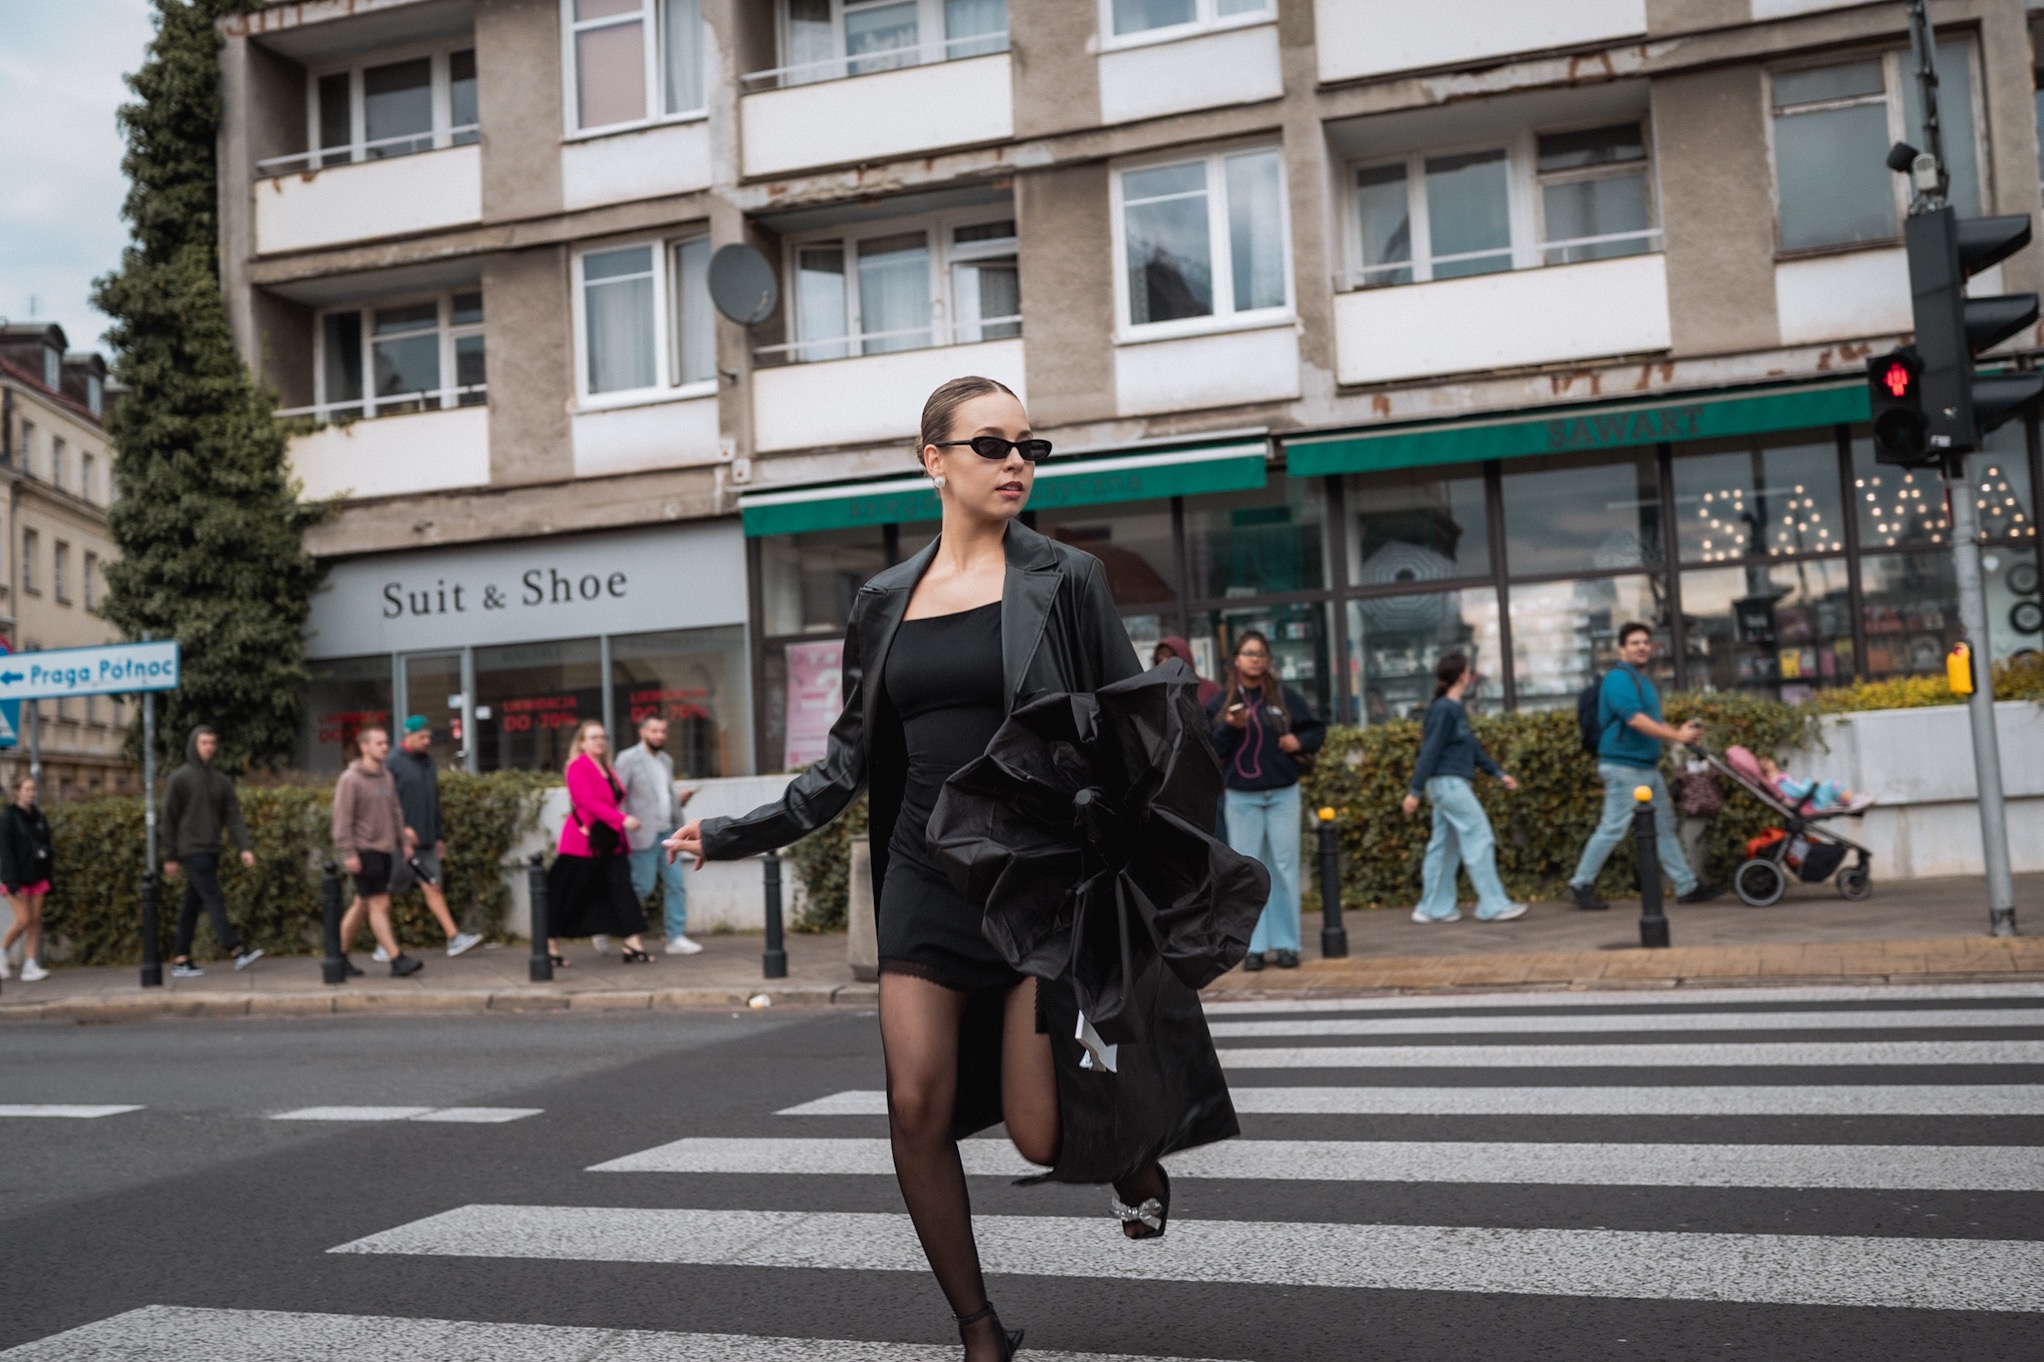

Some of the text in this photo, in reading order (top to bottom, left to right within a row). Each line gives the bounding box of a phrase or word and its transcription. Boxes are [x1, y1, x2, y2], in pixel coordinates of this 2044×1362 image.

[1548, 403, 1704, 448] SAWART
[383, 567, 627, 618] Suit & Shoe
[31, 657, 173, 688] Praga Północ
[503, 714, 531, 732] DO
